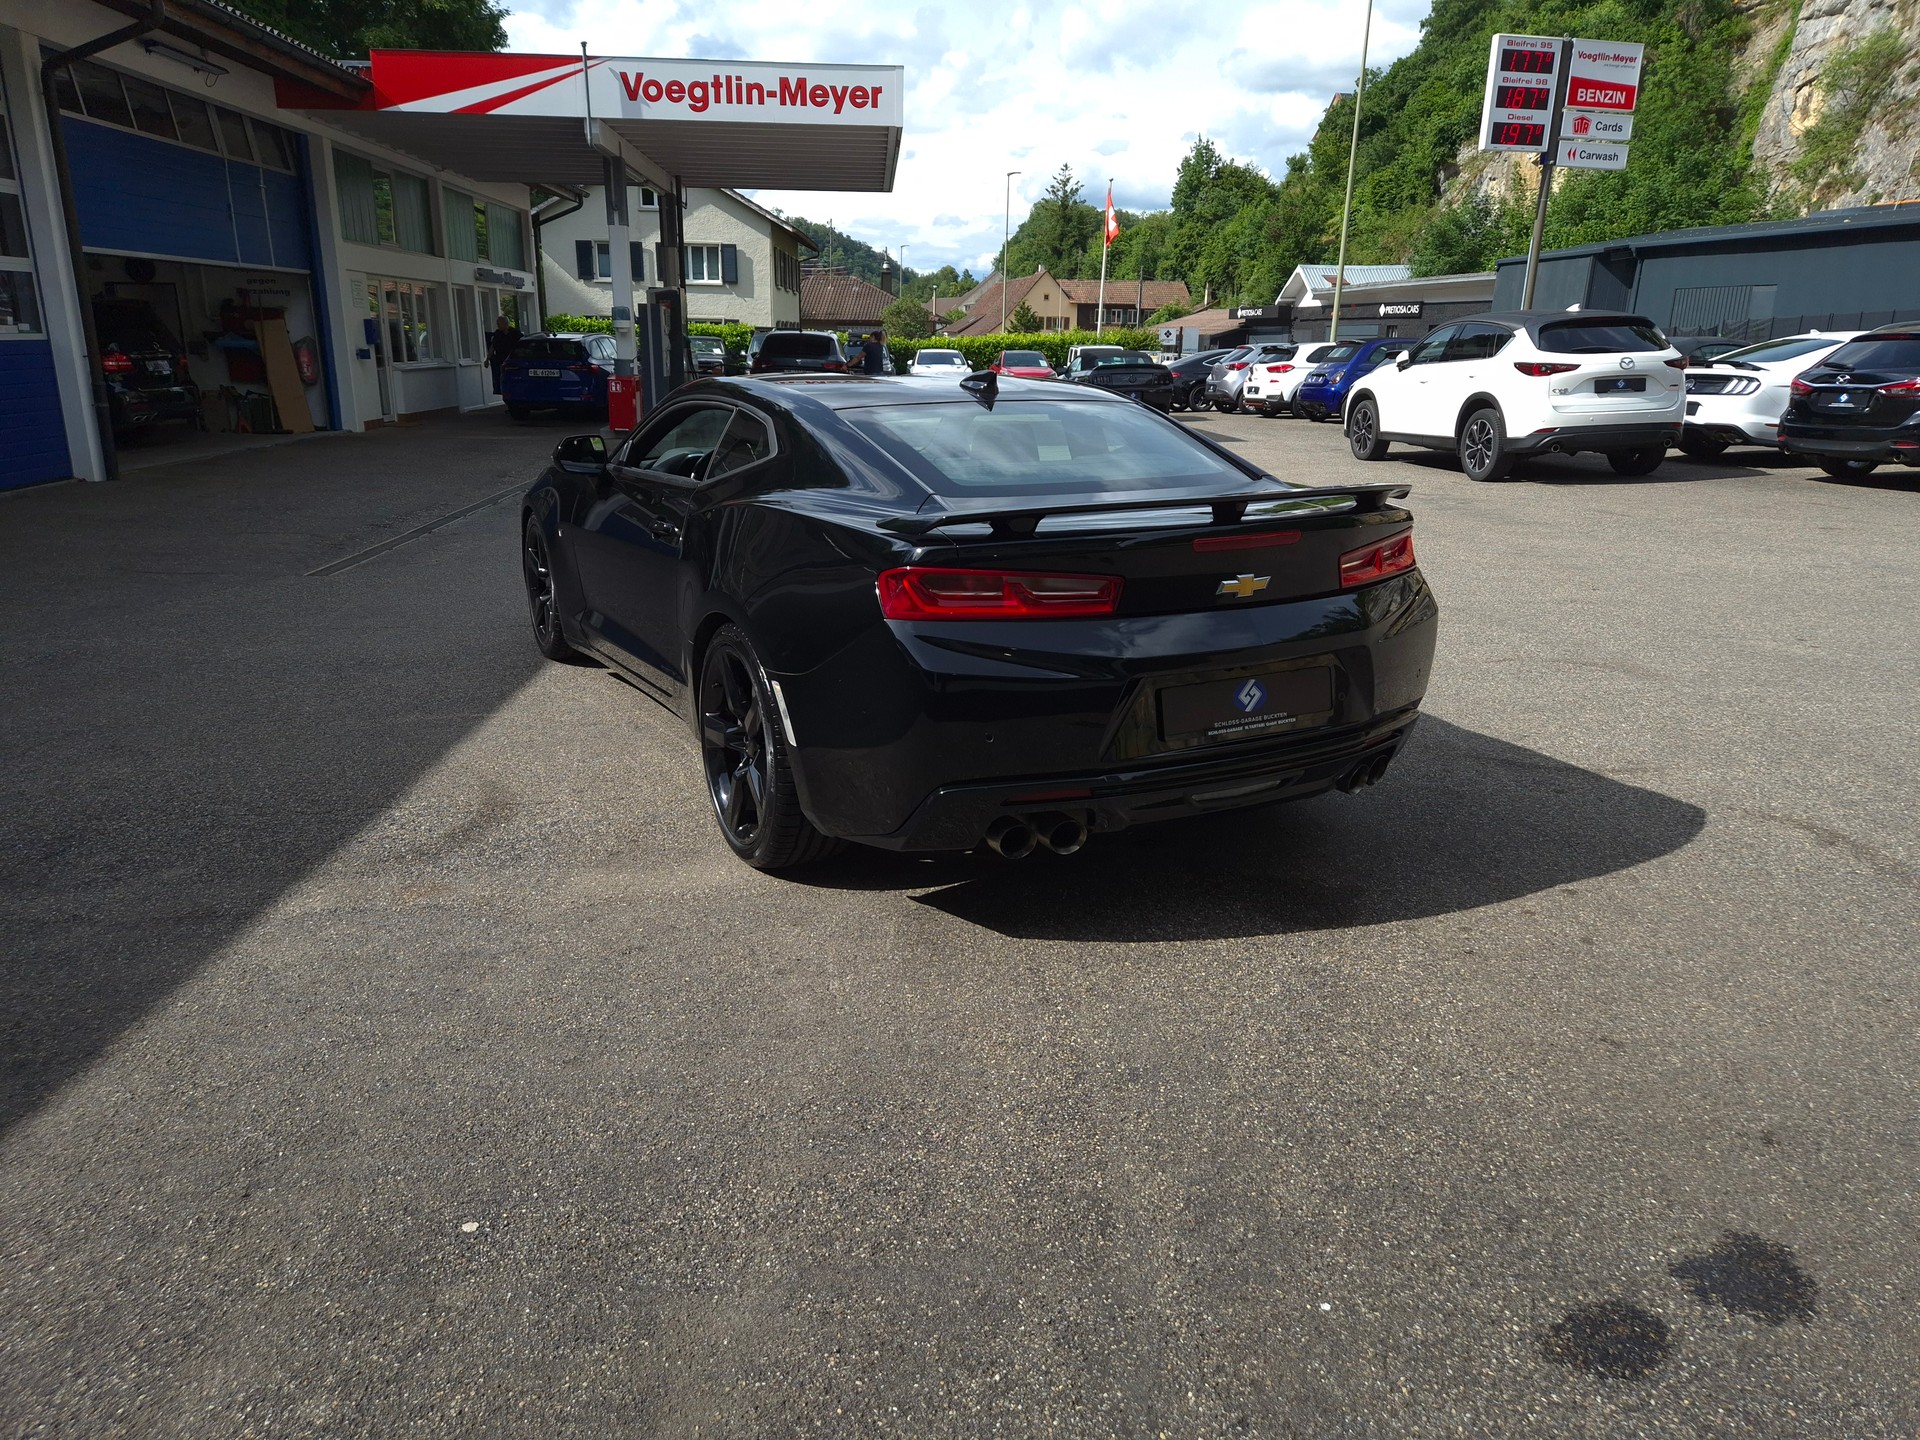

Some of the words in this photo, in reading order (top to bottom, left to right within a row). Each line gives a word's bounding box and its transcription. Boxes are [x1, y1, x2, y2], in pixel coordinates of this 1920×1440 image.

[1507, 39, 1537, 48] Bleifrei
[1540, 41, 1553, 49] 95
[1577, 50, 1637, 64] Voegtlin-Meyer
[1502, 76, 1533, 85] Bleifrei
[619, 71, 883, 114] Voegtlin-Meyer
[1577, 88, 1626, 105] BENZIN
[1507, 113, 1534, 121] Diesel
[1595, 120, 1623, 133] Cards
[1579, 150, 1619, 161] Carwash
[1406, 304, 1420, 314] CARS
[1263, 711, 1288, 721] BUCKTEN
